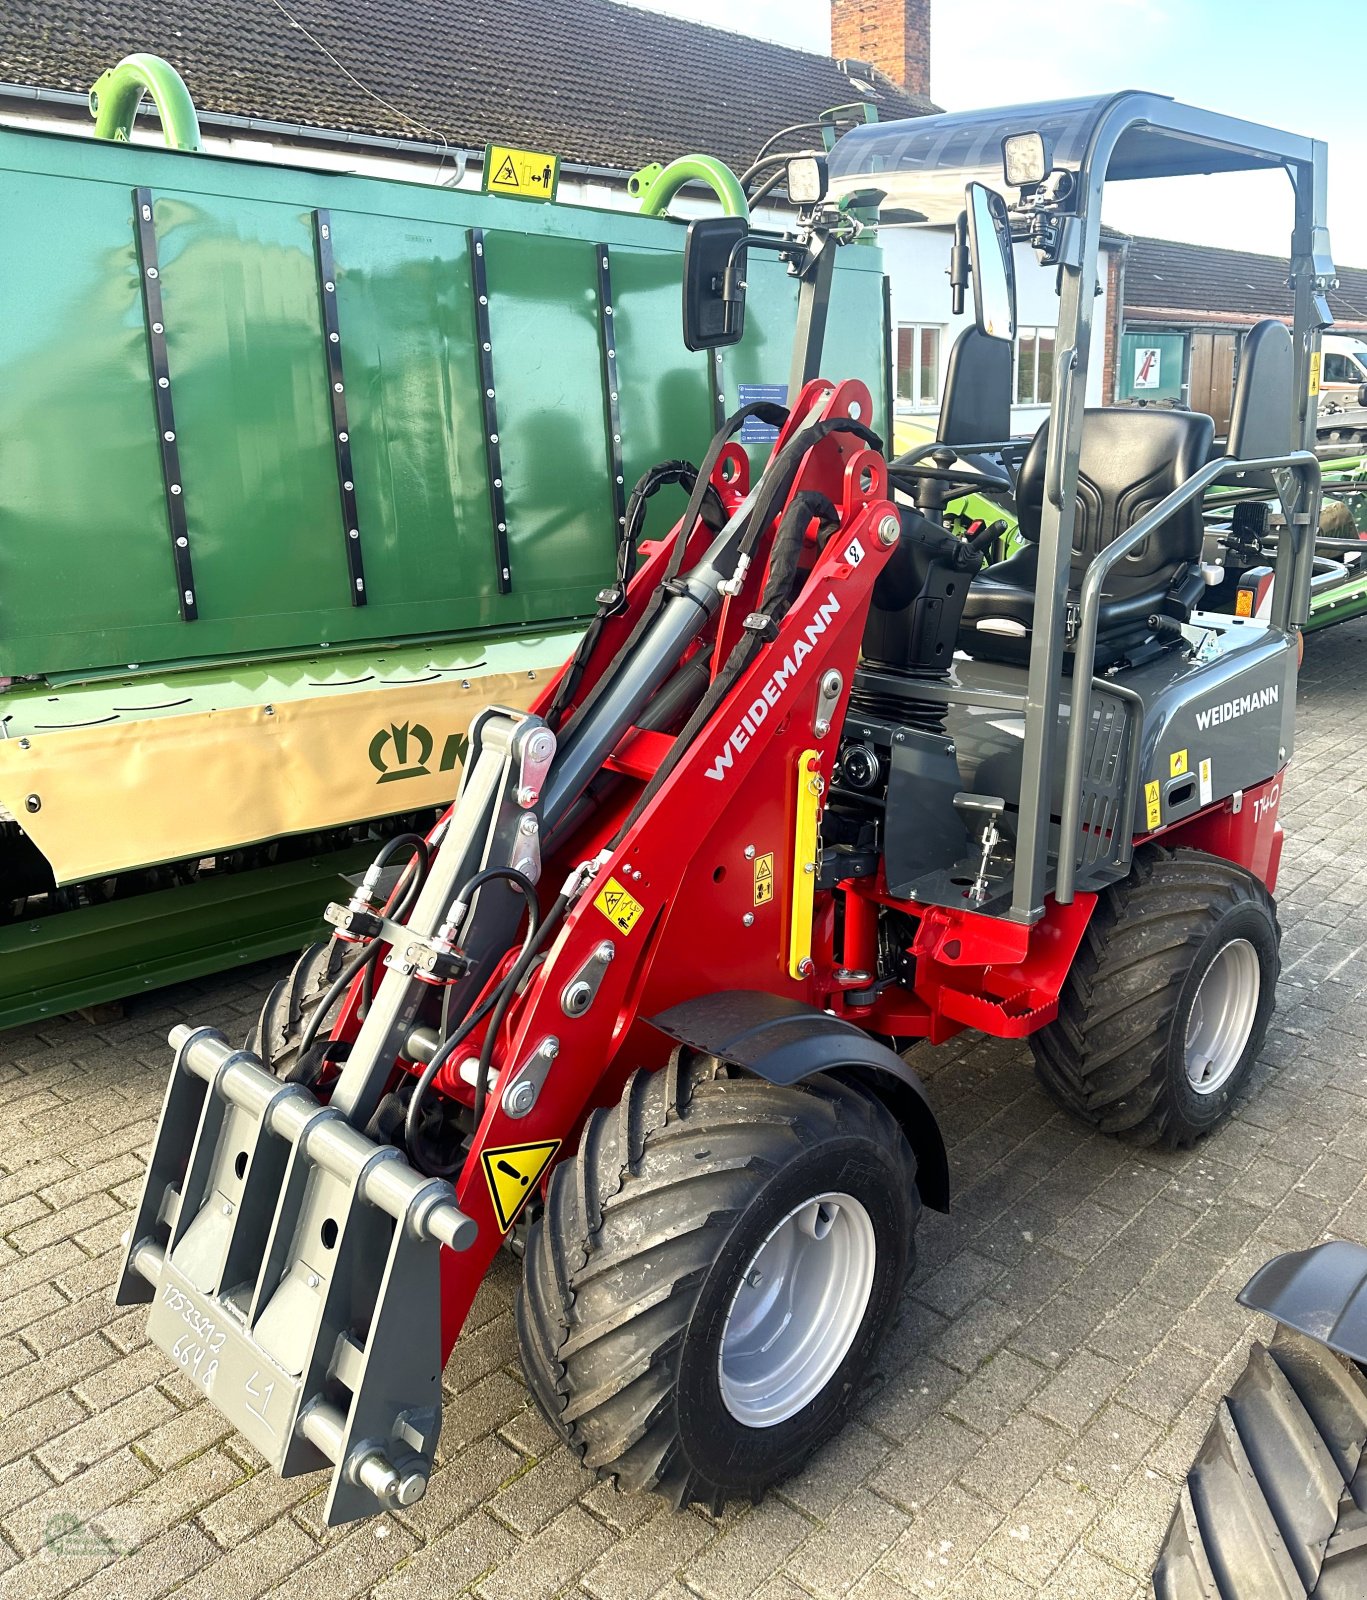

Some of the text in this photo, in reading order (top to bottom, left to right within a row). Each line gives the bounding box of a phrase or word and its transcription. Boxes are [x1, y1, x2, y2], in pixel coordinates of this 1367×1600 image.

[704, 592, 841, 781] WEIDEMANN
[1196, 685, 1279, 731] WEIDEMANN
[1253, 784, 1279, 823] 1140
[172, 1333, 219, 1386] 6648
